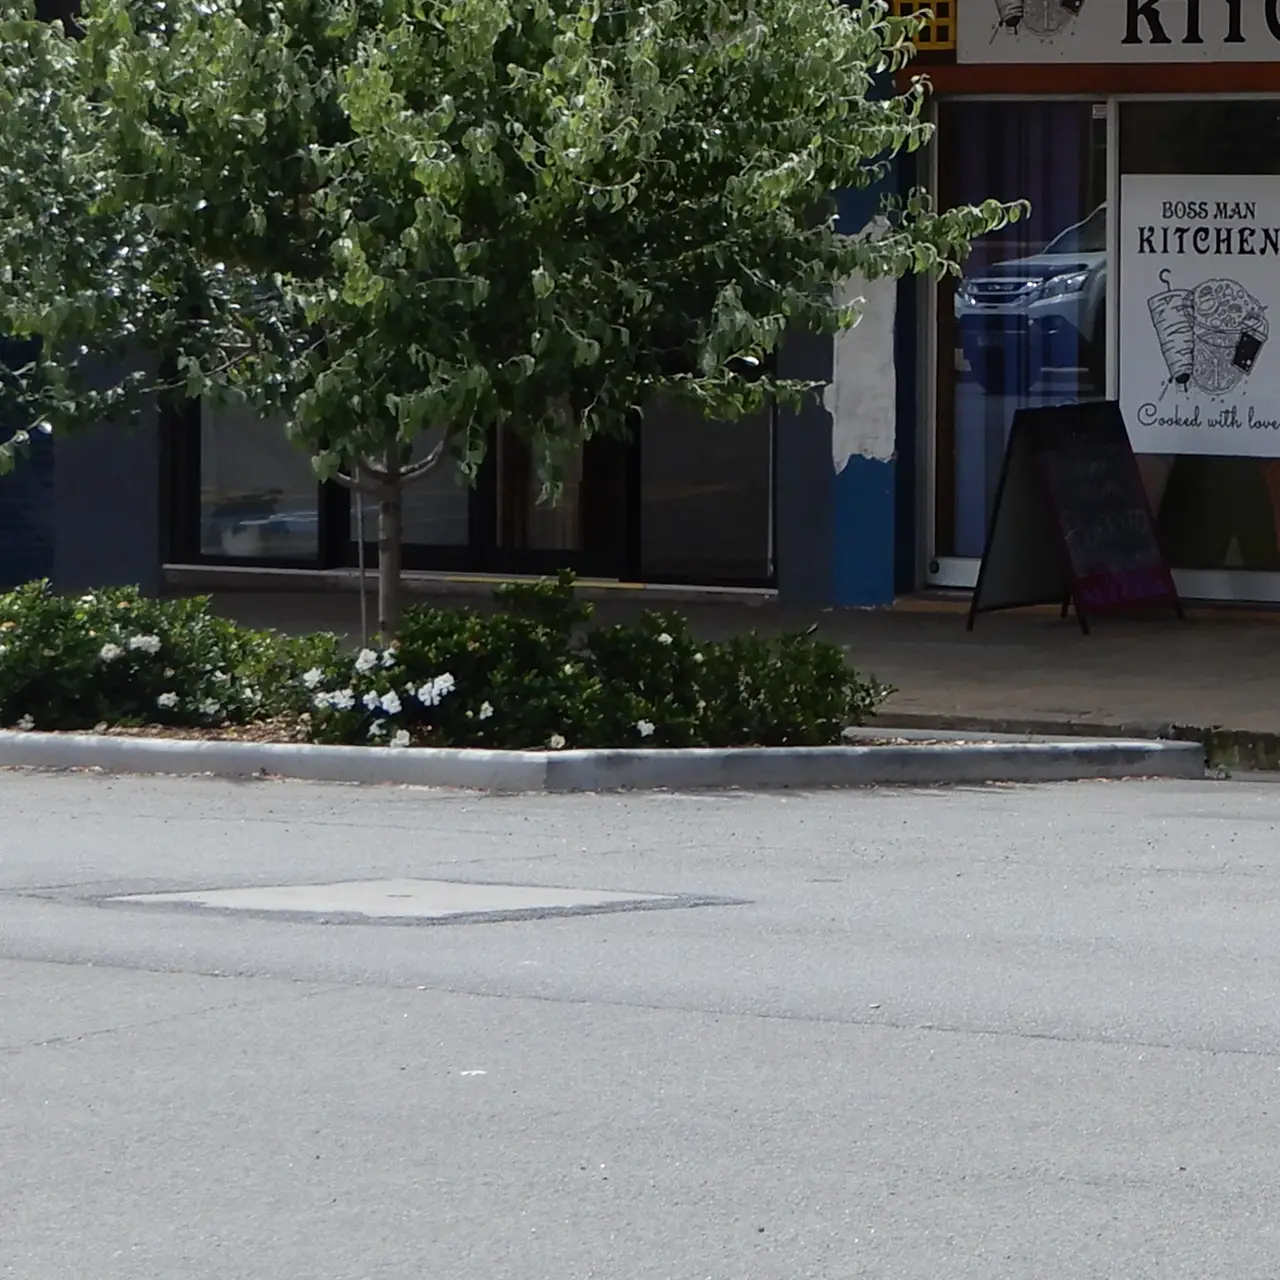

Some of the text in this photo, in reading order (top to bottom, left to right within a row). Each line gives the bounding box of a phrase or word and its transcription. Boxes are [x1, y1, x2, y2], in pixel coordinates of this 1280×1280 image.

[1161, 201, 1257, 220] BOSS MAN
[1138, 226, 1280, 255] KITCHEN
[1137, 402, 1280, 430] Cooked with love
